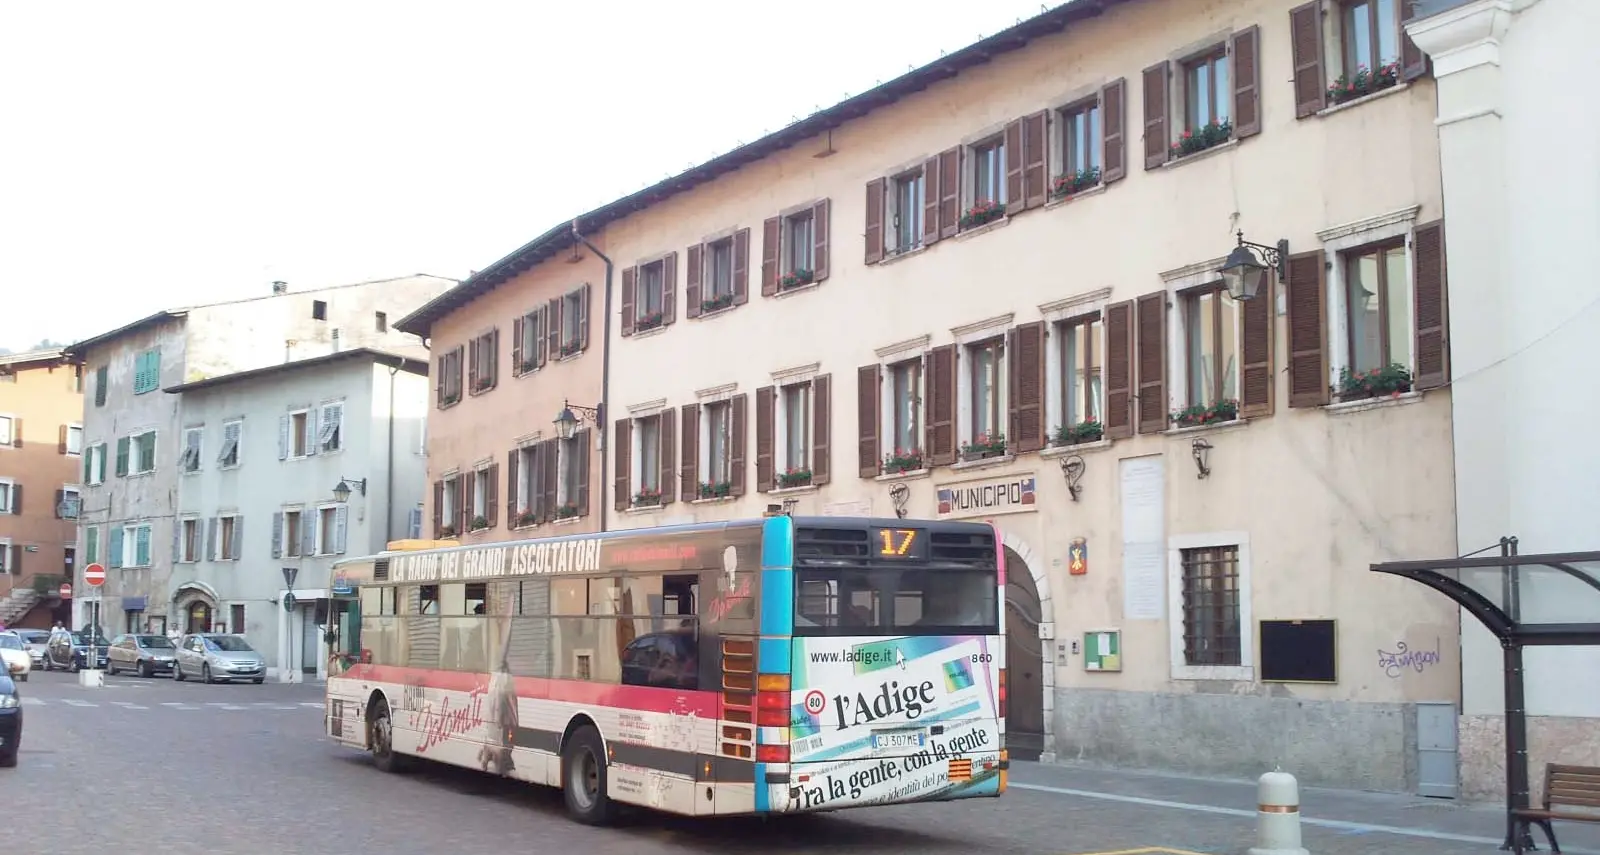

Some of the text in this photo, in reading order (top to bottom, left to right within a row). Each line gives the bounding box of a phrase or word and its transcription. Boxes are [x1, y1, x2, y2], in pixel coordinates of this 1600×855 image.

[951, 482, 1020, 510] MUNICIPIO
[880, 529, 916, 555] 17
[393, 557, 405, 582] LA
[408, 553, 438, 580] RADIO
[441, 551, 460, 578] DEI
[463, 547, 506, 577] GRANDI
[510, 539, 602, 575] ASCOLTATORI
[810, 649, 893, 665] www.ladige.it
[971, 654, 993, 663] 860
[809, 697, 821, 708] 80
[833, 681, 936, 731] l'Adige
[827, 775, 846, 800] la
[848, 760, 902, 799] gente,
[903, 749, 929, 772] con
[931, 740, 950, 762] la
[949, 728, 989, 761] gente
[887, 779, 920, 802] identità
[922, 772, 935, 789] del
